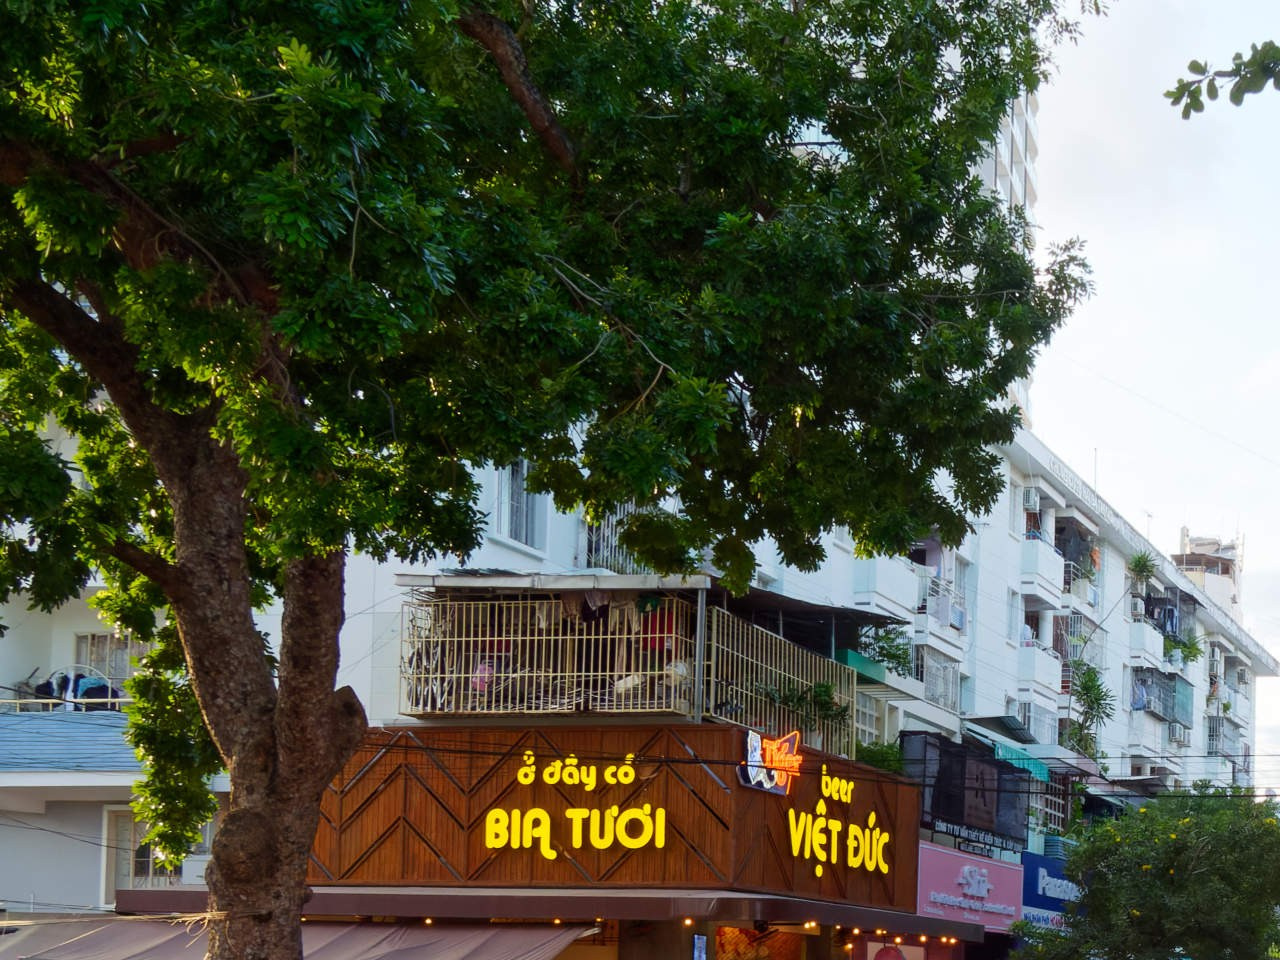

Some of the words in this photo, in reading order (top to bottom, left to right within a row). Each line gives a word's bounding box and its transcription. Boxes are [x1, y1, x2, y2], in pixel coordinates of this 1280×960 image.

[821, 763, 855, 804] beer
[485, 808, 557, 860] BIA
[565, 803, 666, 850] TƯƠI
[788, 798, 842, 878] VIỆT
[847, 810, 890, 874] ĐỨC
